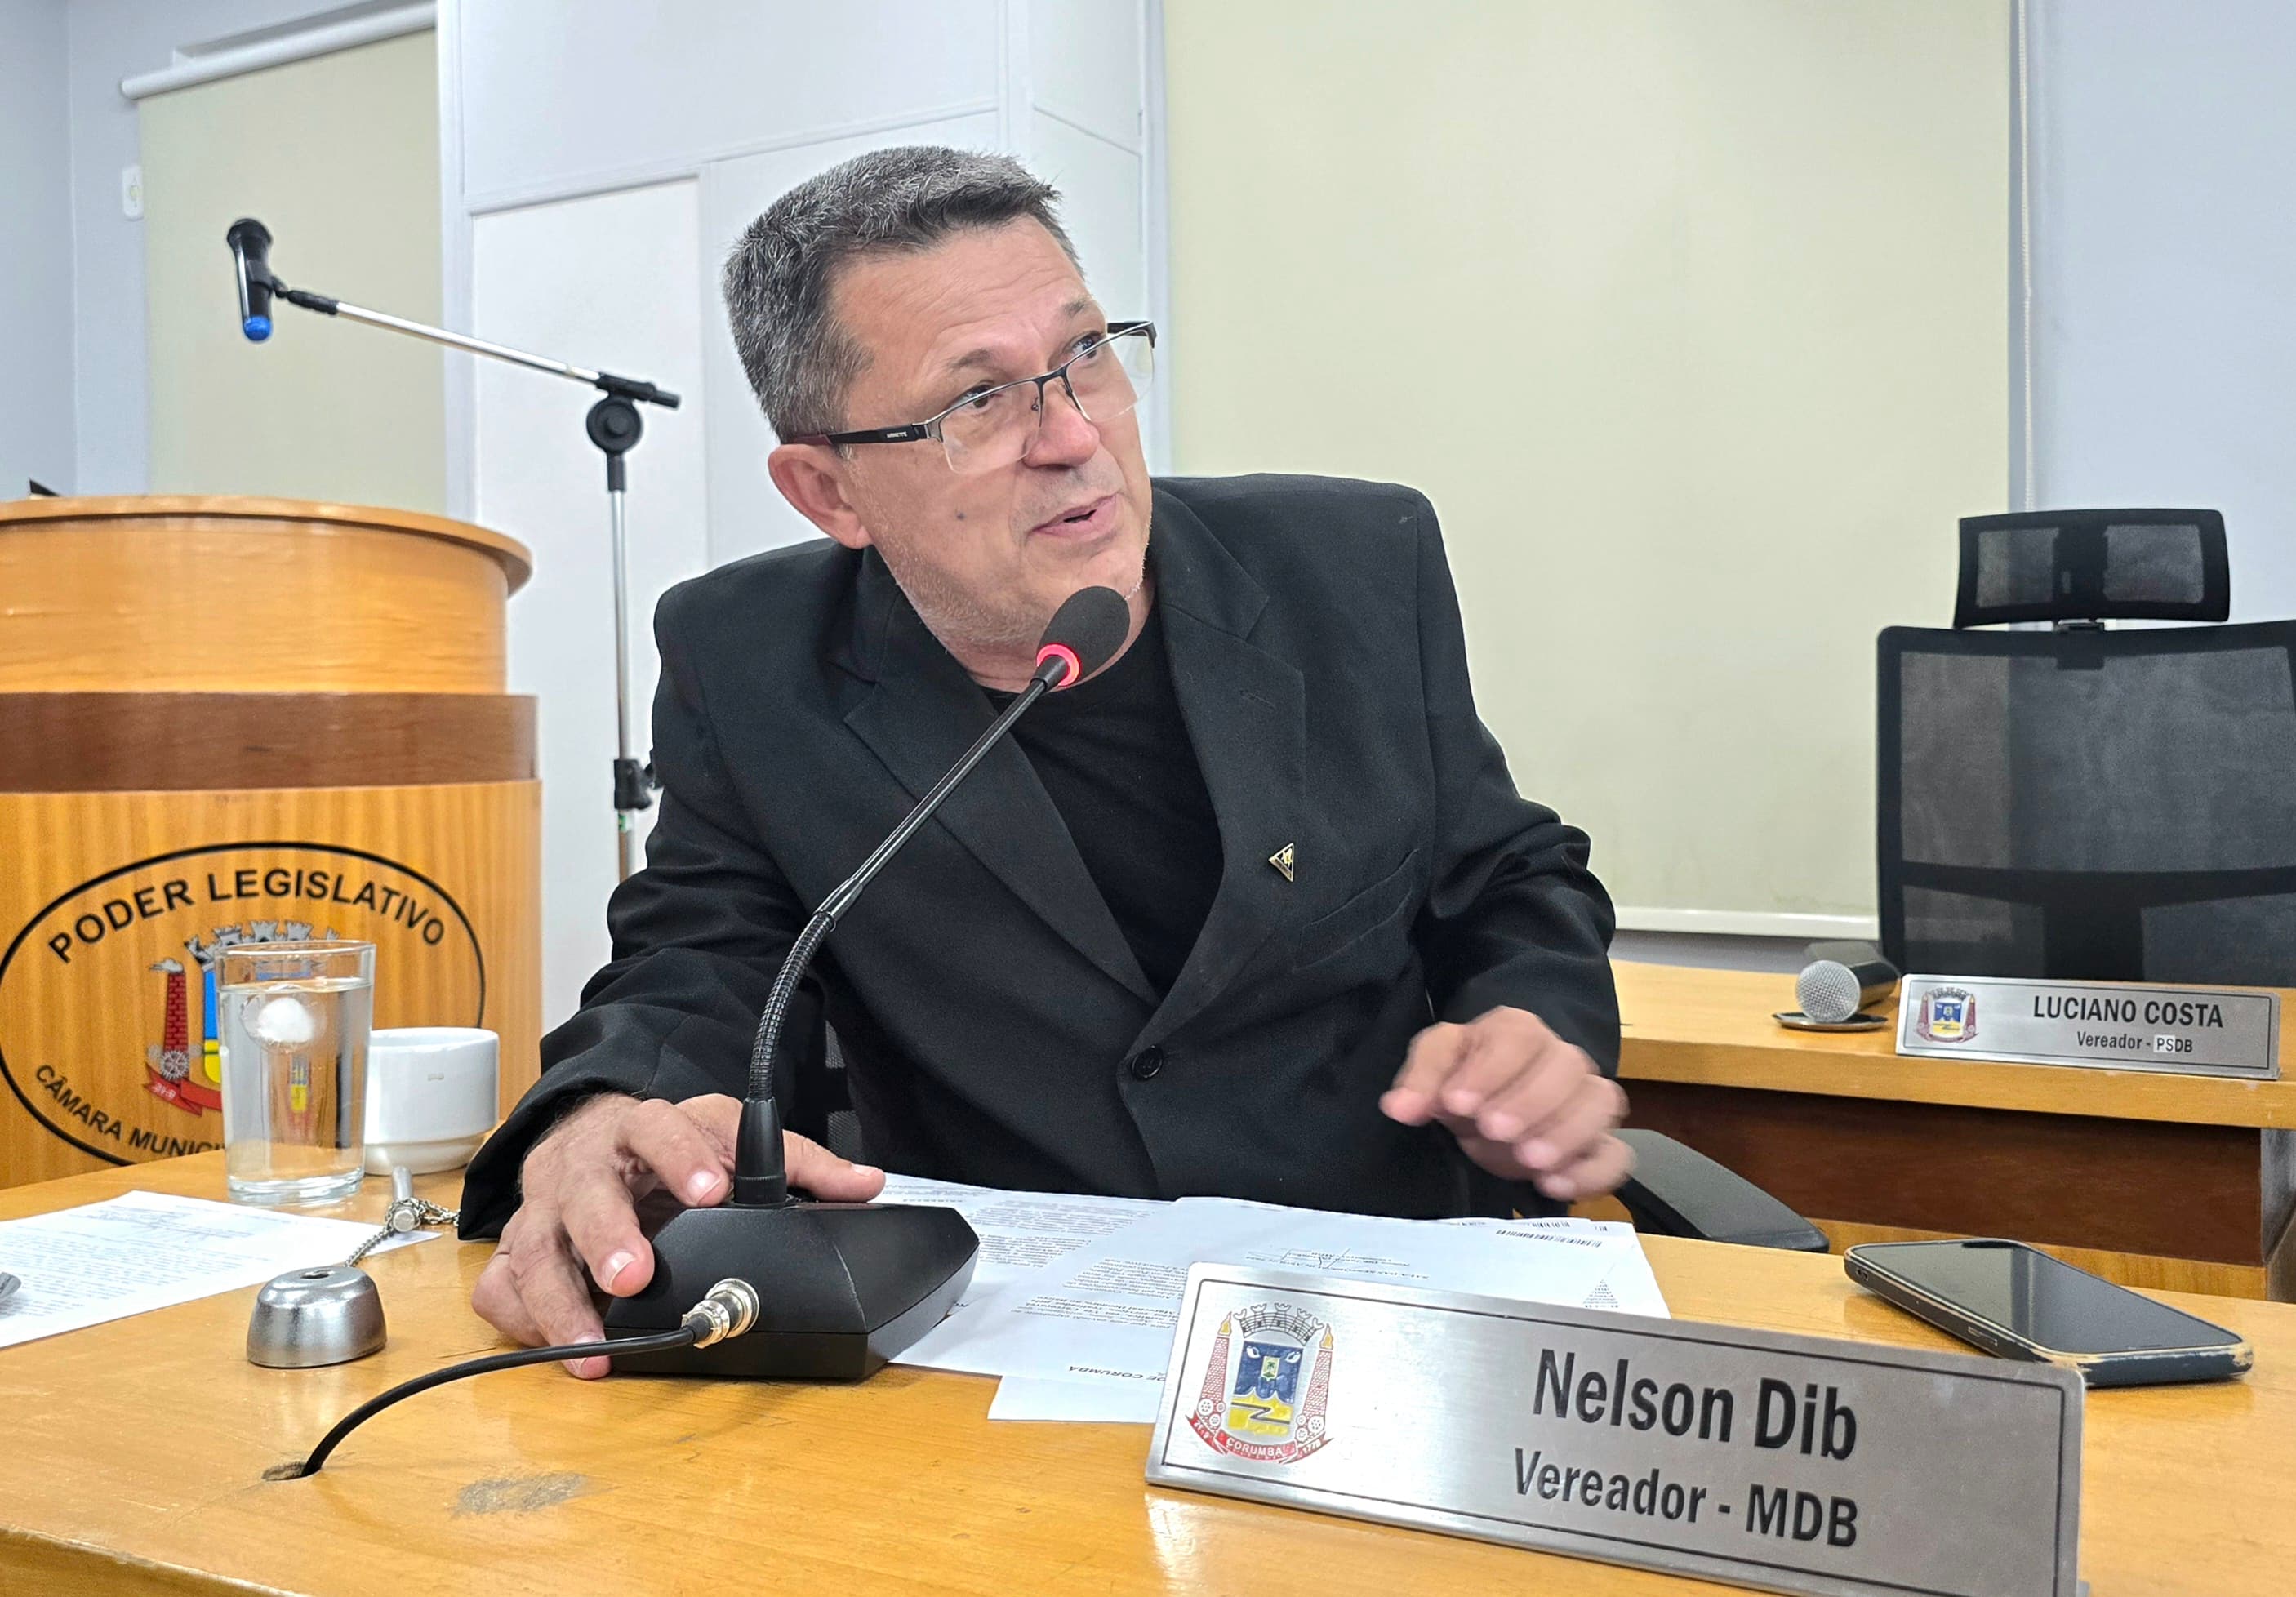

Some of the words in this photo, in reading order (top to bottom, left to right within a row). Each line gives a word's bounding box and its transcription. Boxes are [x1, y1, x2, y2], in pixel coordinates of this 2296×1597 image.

[48, 880, 194, 963] PODER
[207, 868, 445, 946] LEGISLATIVO
[2034, 995, 2137, 1023] LUCIANO
[2144, 1001, 2224, 1029] COSTA
[2077, 1031, 2143, 1050] Vereador
[2157, 1038, 2194, 1053] PSDB
[35, 1064, 122, 1141] CÂMARA
[1533, 1348, 1735, 1444] Nelson
[1753, 1377, 1858, 1462] Dib
[1514, 1447, 1708, 1524] Vereador
[1745, 1483, 1859, 1549] MDB
